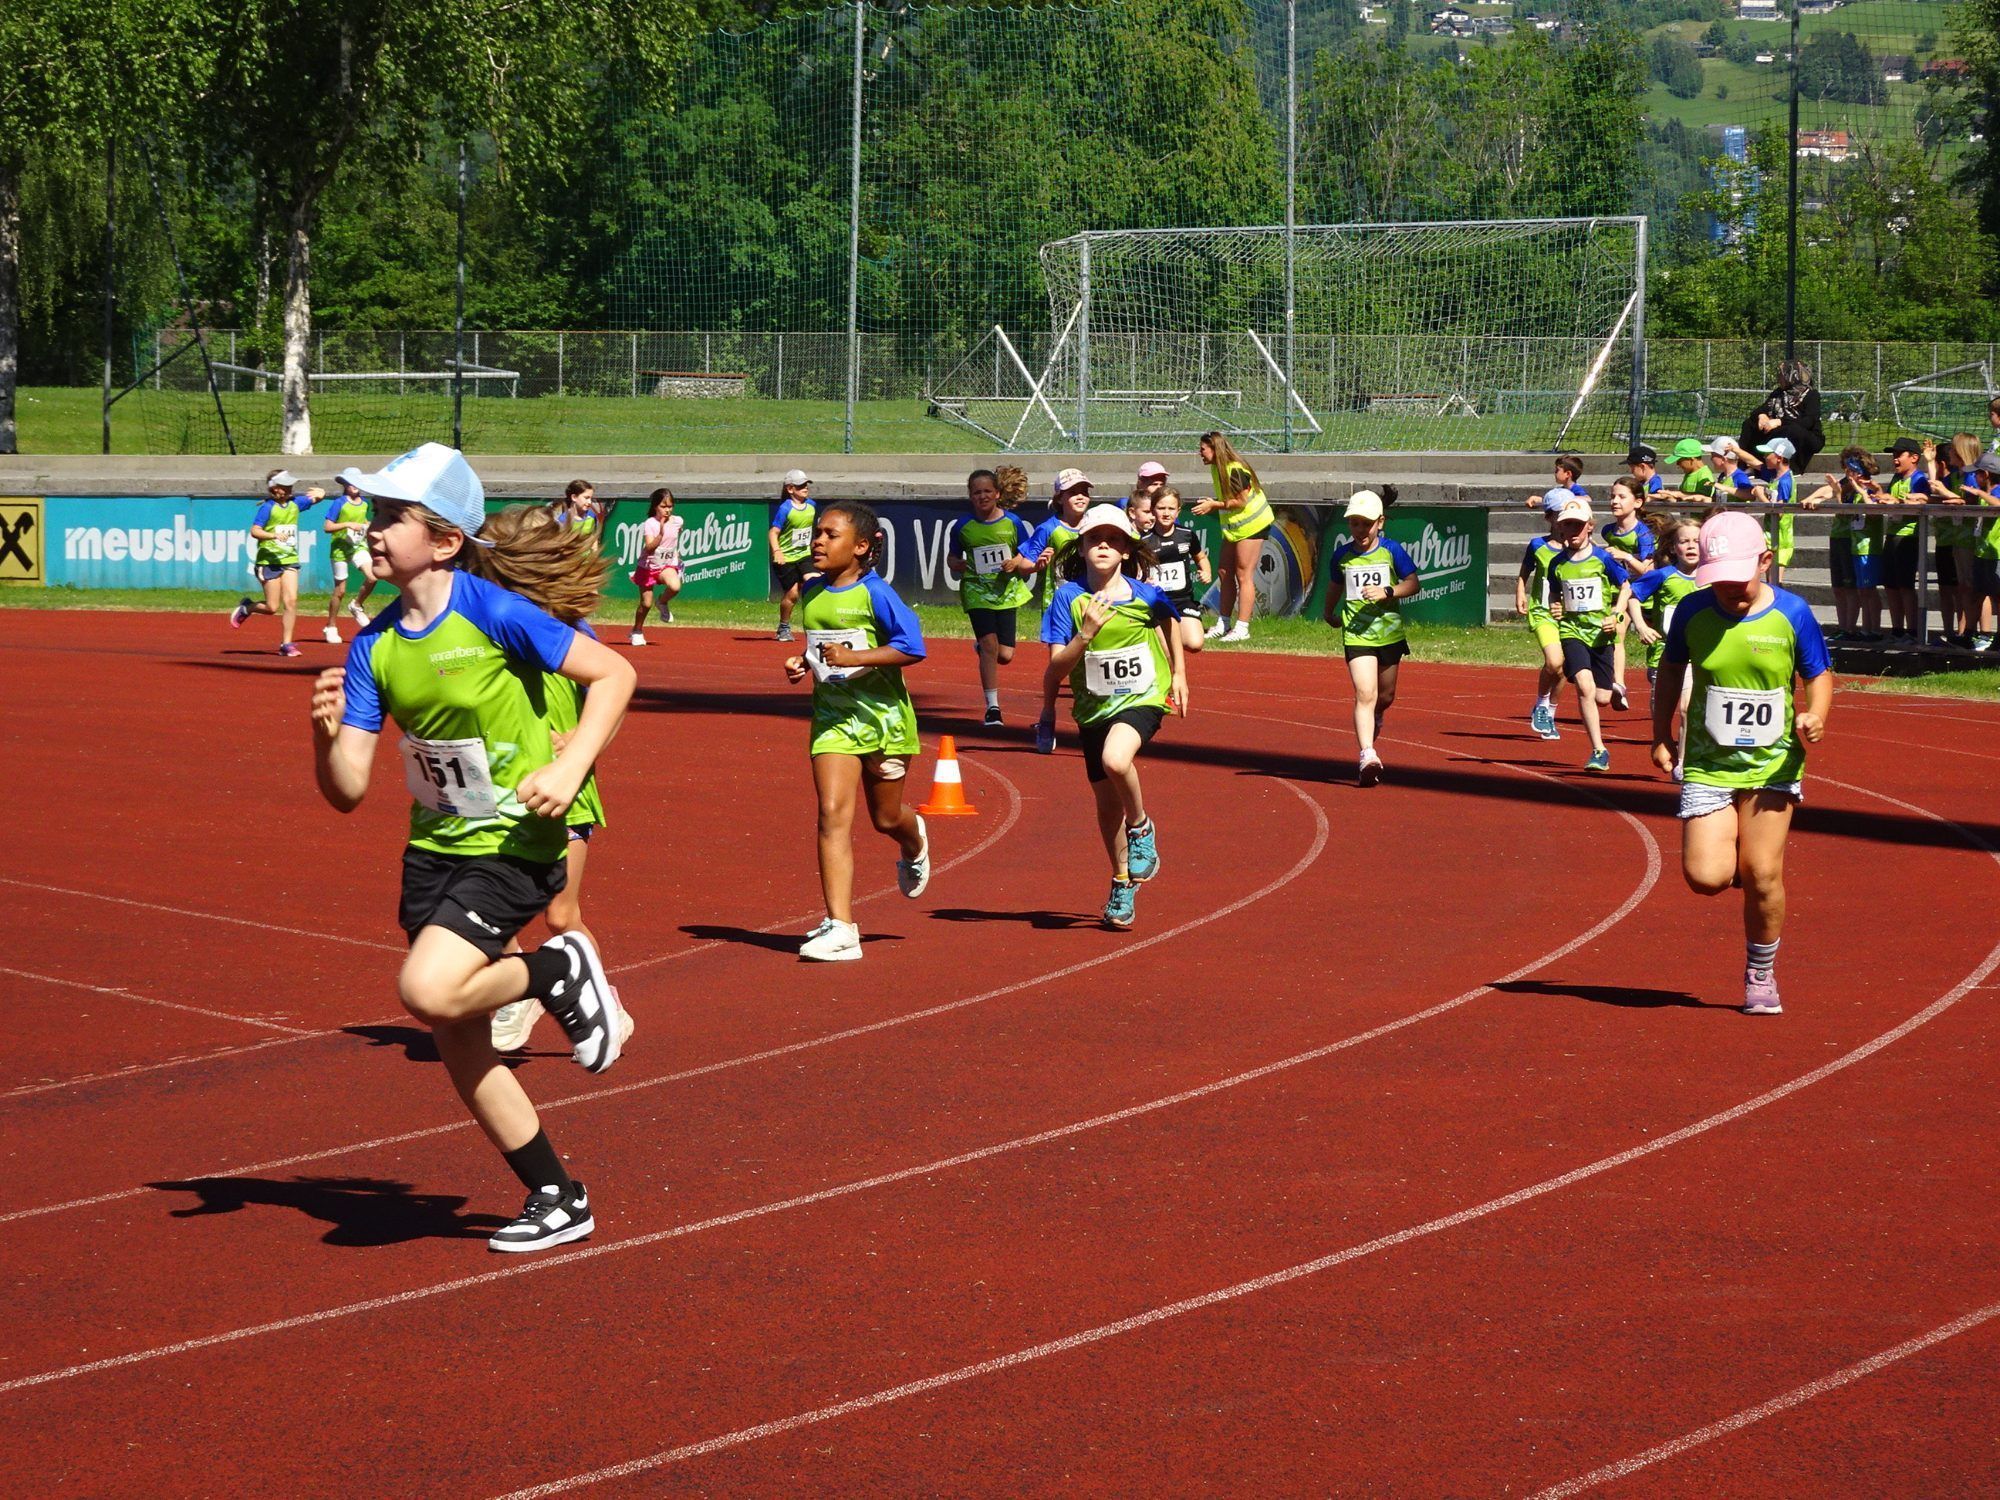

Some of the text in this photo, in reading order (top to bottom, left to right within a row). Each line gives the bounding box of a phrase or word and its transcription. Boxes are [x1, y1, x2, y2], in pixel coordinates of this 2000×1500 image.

[615, 512, 752, 566] Menbräu
[981, 550, 1005, 564] 111
[729, 560, 746, 573] Bier
[1352, 572, 1382, 587] 129
[1449, 580, 1466, 593] Bier
[1568, 585, 1595, 600] 137
[1099, 656, 1142, 680] 165
[1722, 701, 1773, 727] 120
[412, 752, 467, 789] 151
